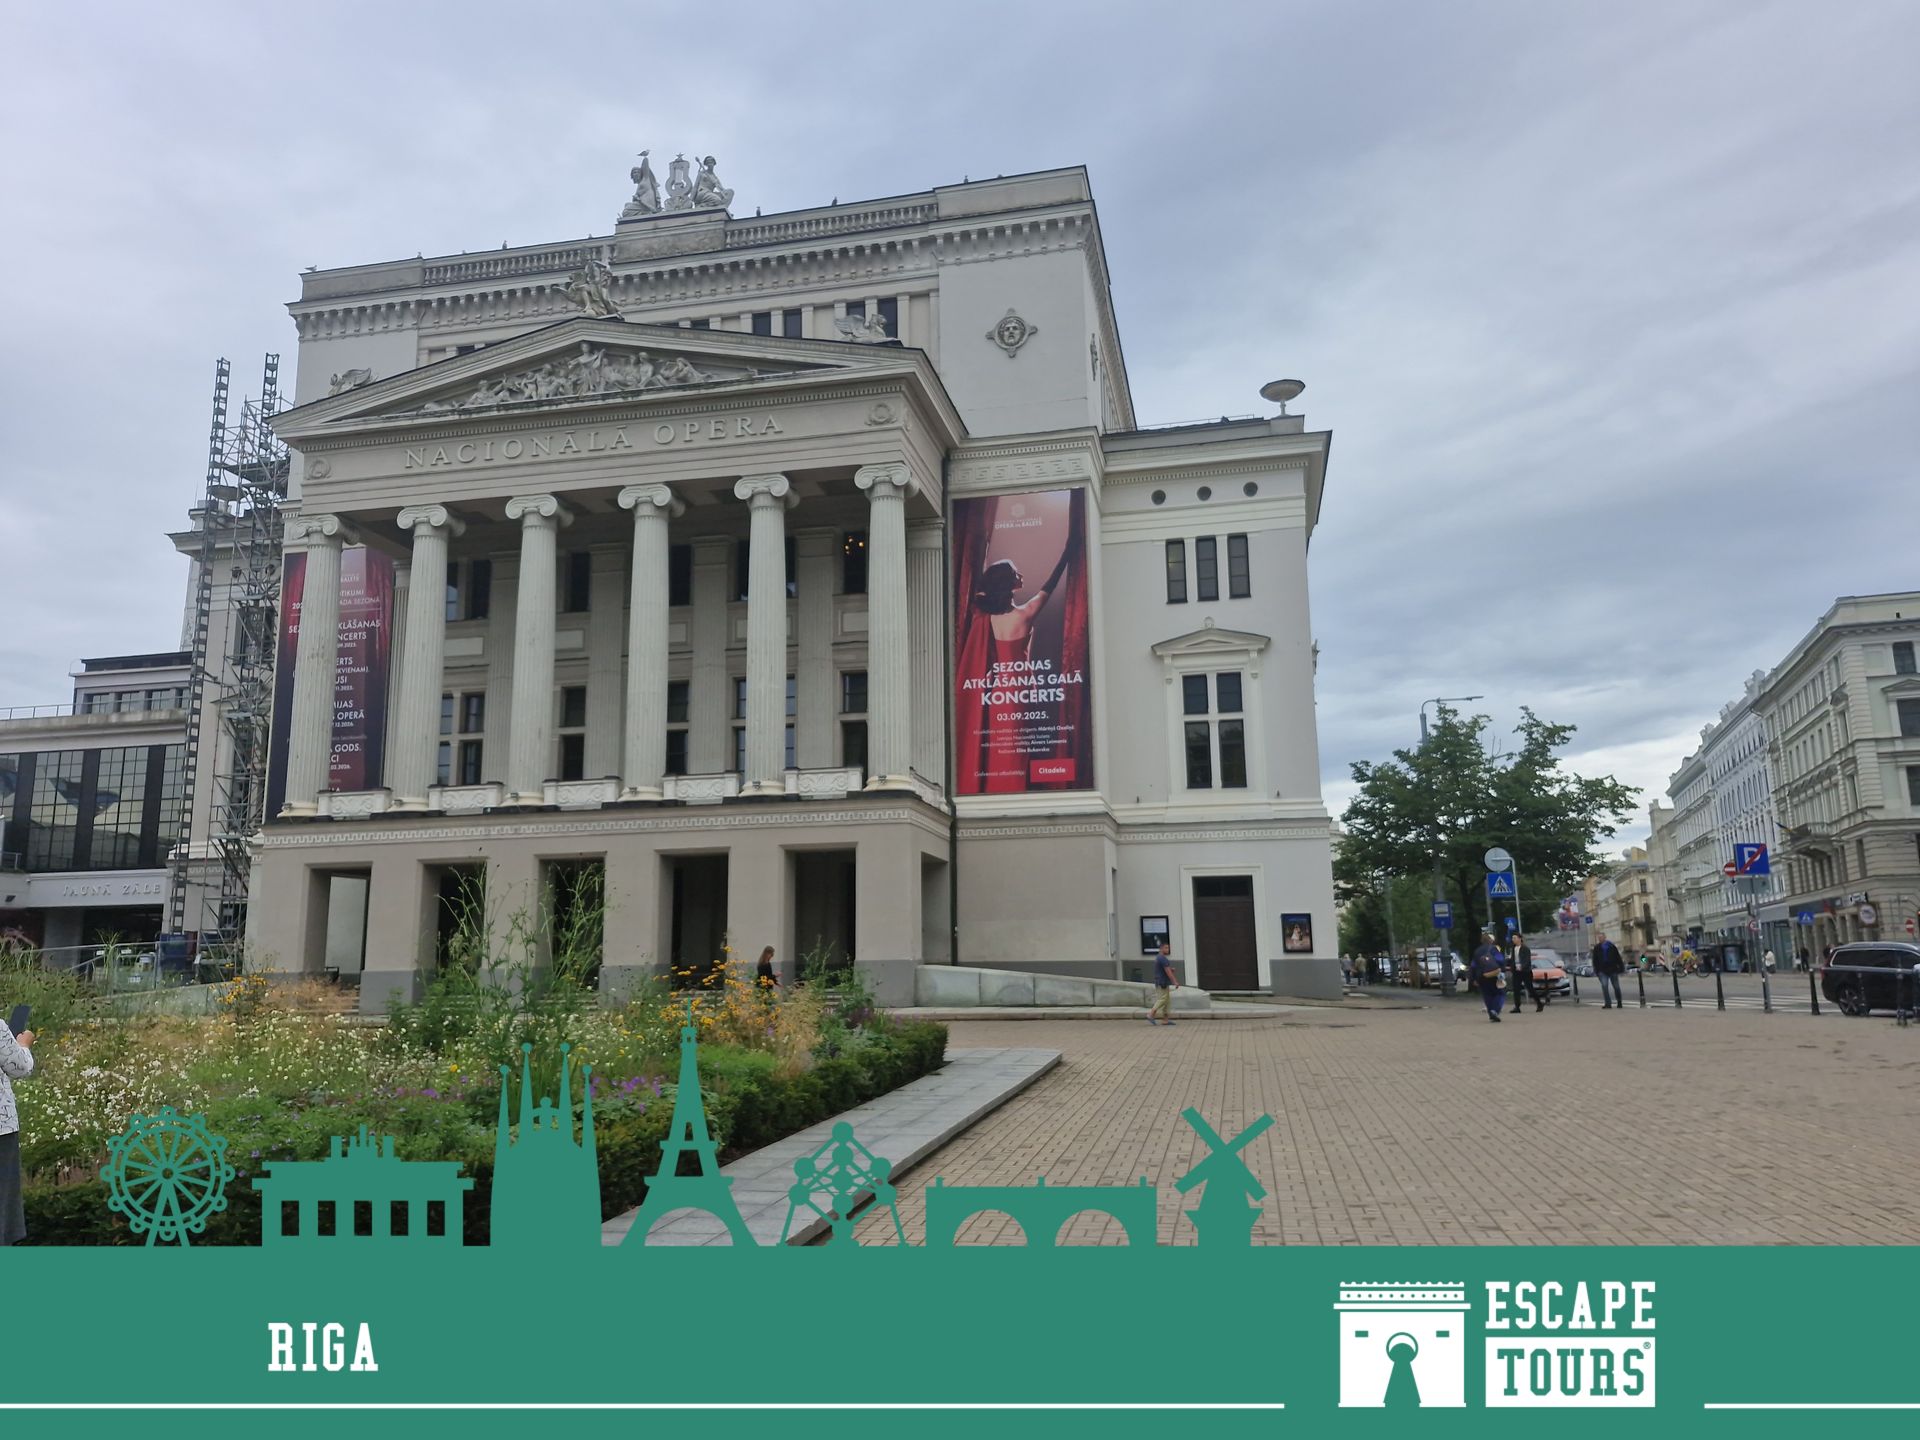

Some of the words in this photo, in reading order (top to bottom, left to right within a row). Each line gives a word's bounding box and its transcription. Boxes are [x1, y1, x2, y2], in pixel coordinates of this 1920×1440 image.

[404, 425, 633, 469] NACIONĀLĀ
[653, 414, 784, 445] OPERA
[338, 618, 381, 631] KLĀŠANAS
[338, 631, 367, 642] NCERTS
[992, 659, 1052, 674] SEZONAS
[962, 673, 1045, 690] ATKLĀŠANAS
[1047, 670, 1083, 685] GALĀ
[981, 688, 1065, 706] KONCERTS
[337, 709, 365, 721] OPERĀ
[996, 710, 1049, 722] 03.09.2025.
[334, 743, 361, 753] GODS.
[1038, 766, 1067, 775] Citadele
